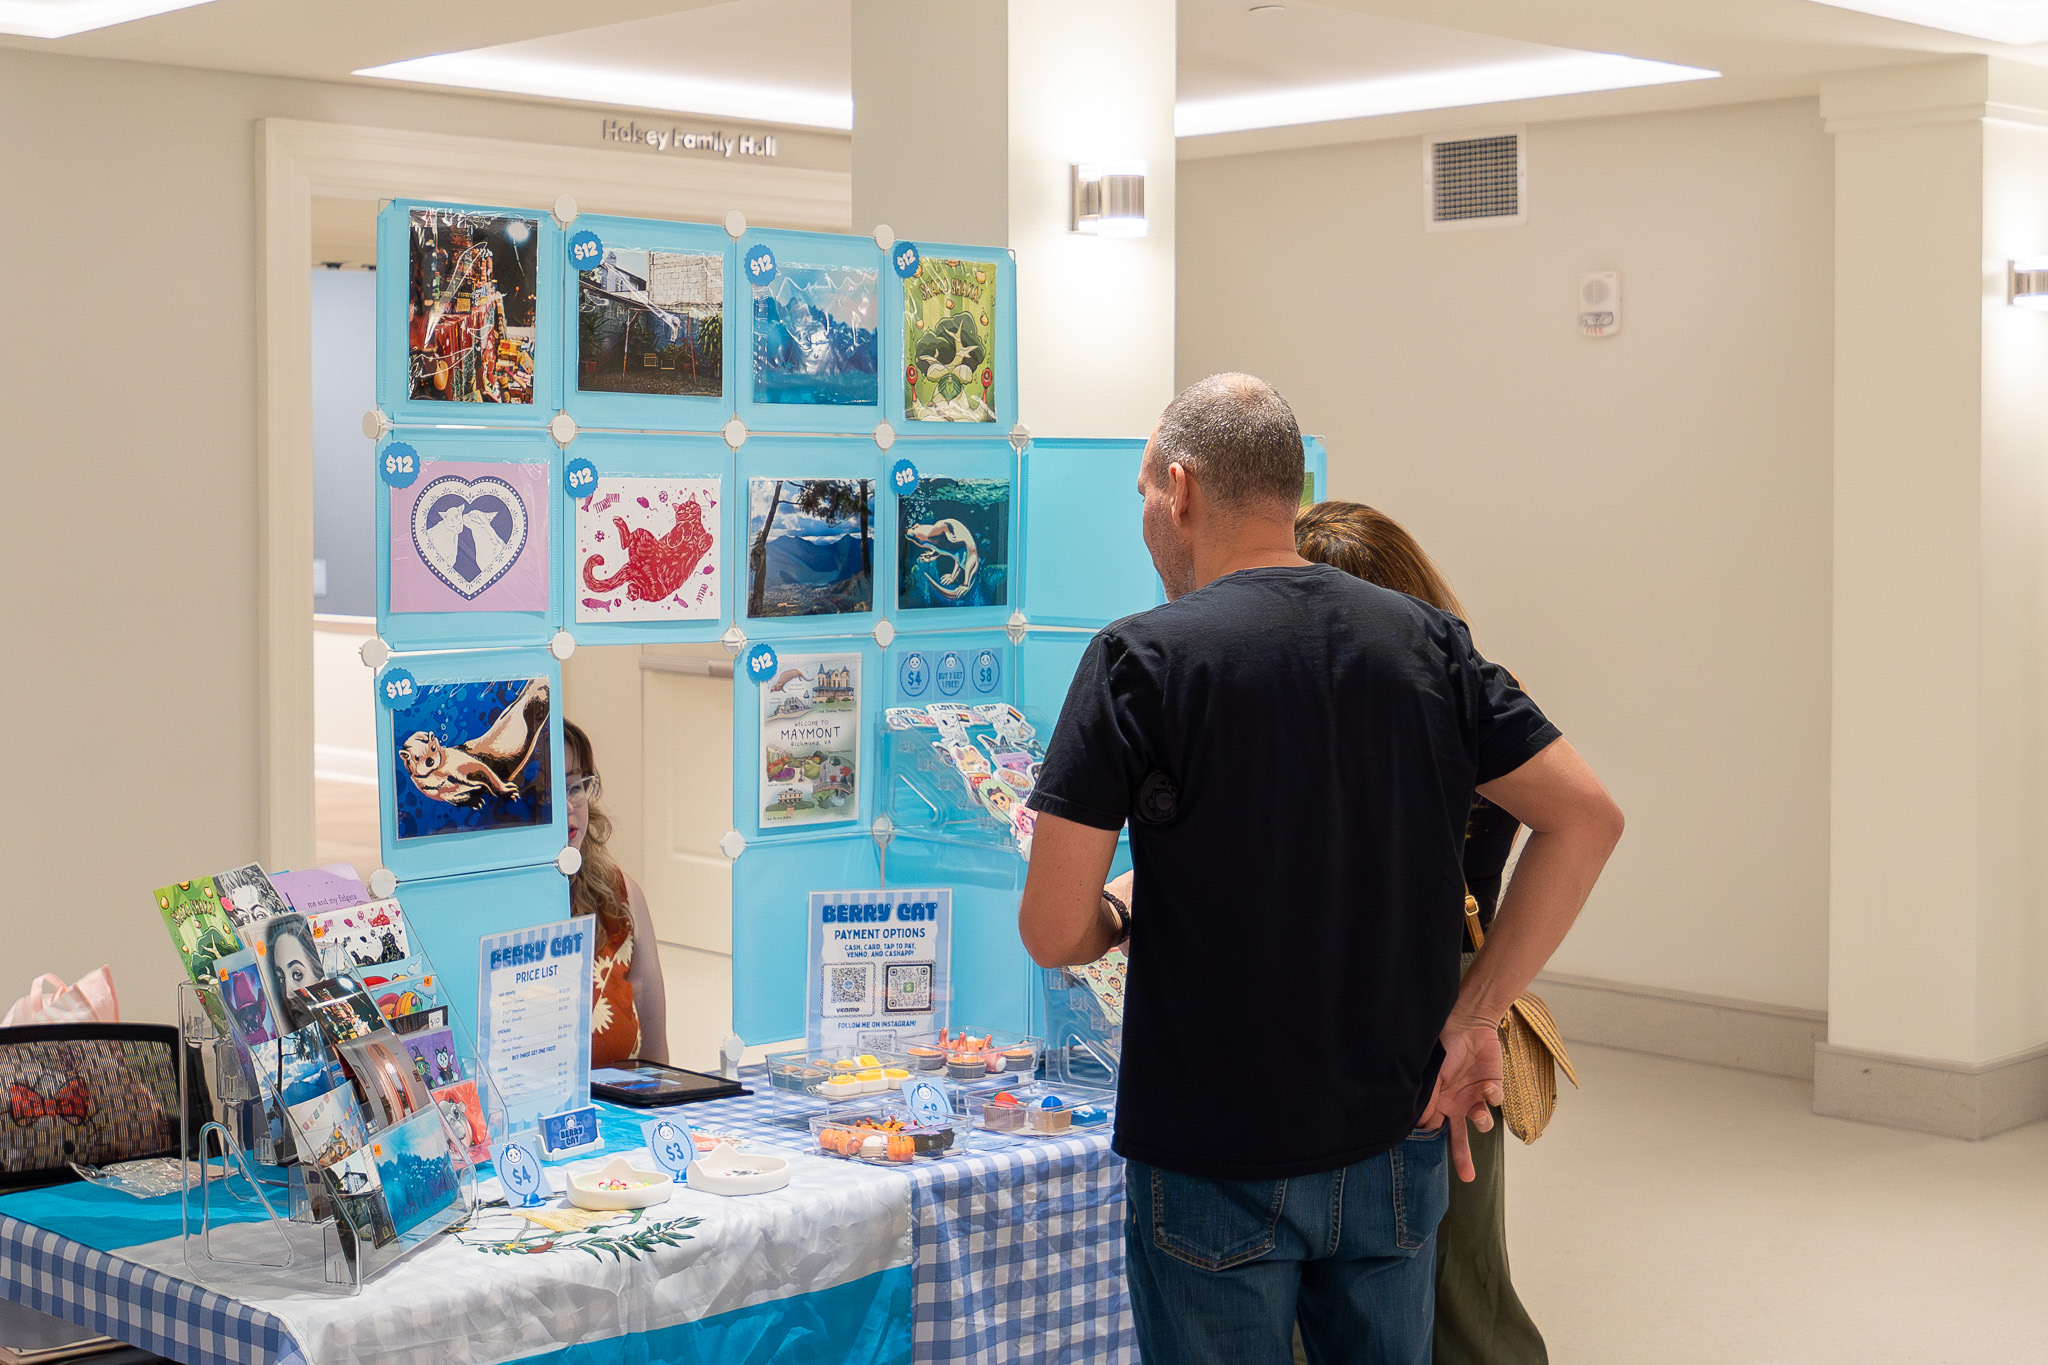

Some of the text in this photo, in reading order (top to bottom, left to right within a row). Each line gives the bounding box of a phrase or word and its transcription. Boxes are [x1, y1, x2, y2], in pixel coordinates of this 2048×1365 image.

[602, 119, 778, 158] Halsey Family Hall
[573, 240, 599, 261] $12
[896, 248, 917, 271] $12
[750, 254, 774, 277] $12
[385, 454, 414, 475] $12
[568, 467, 594, 489] $12
[895, 467, 915, 487] $12
[751, 652, 774, 673] $12
[907, 670, 922, 687] $4
[979, 667, 992, 683] $8
[386, 678, 413, 700] $12
[780, 725, 841, 740] MAYMONT
[317, 898, 328, 907] and
[329, 897, 338, 906] my
[822, 902, 938, 923] BERRY CAT
[834, 927, 926, 940] PAYMENT OPTIONS
[489, 932, 583, 971] BERRY CAT
[515, 964, 559, 984] PRICE LIST
[837, 1021, 861, 1029] FOLLOW
[559, 1125, 584, 1139] BERRY
[565, 1135, 581, 1147] CAT
[665, 1142, 685, 1162] $3
[511, 1164, 532, 1186] $4
